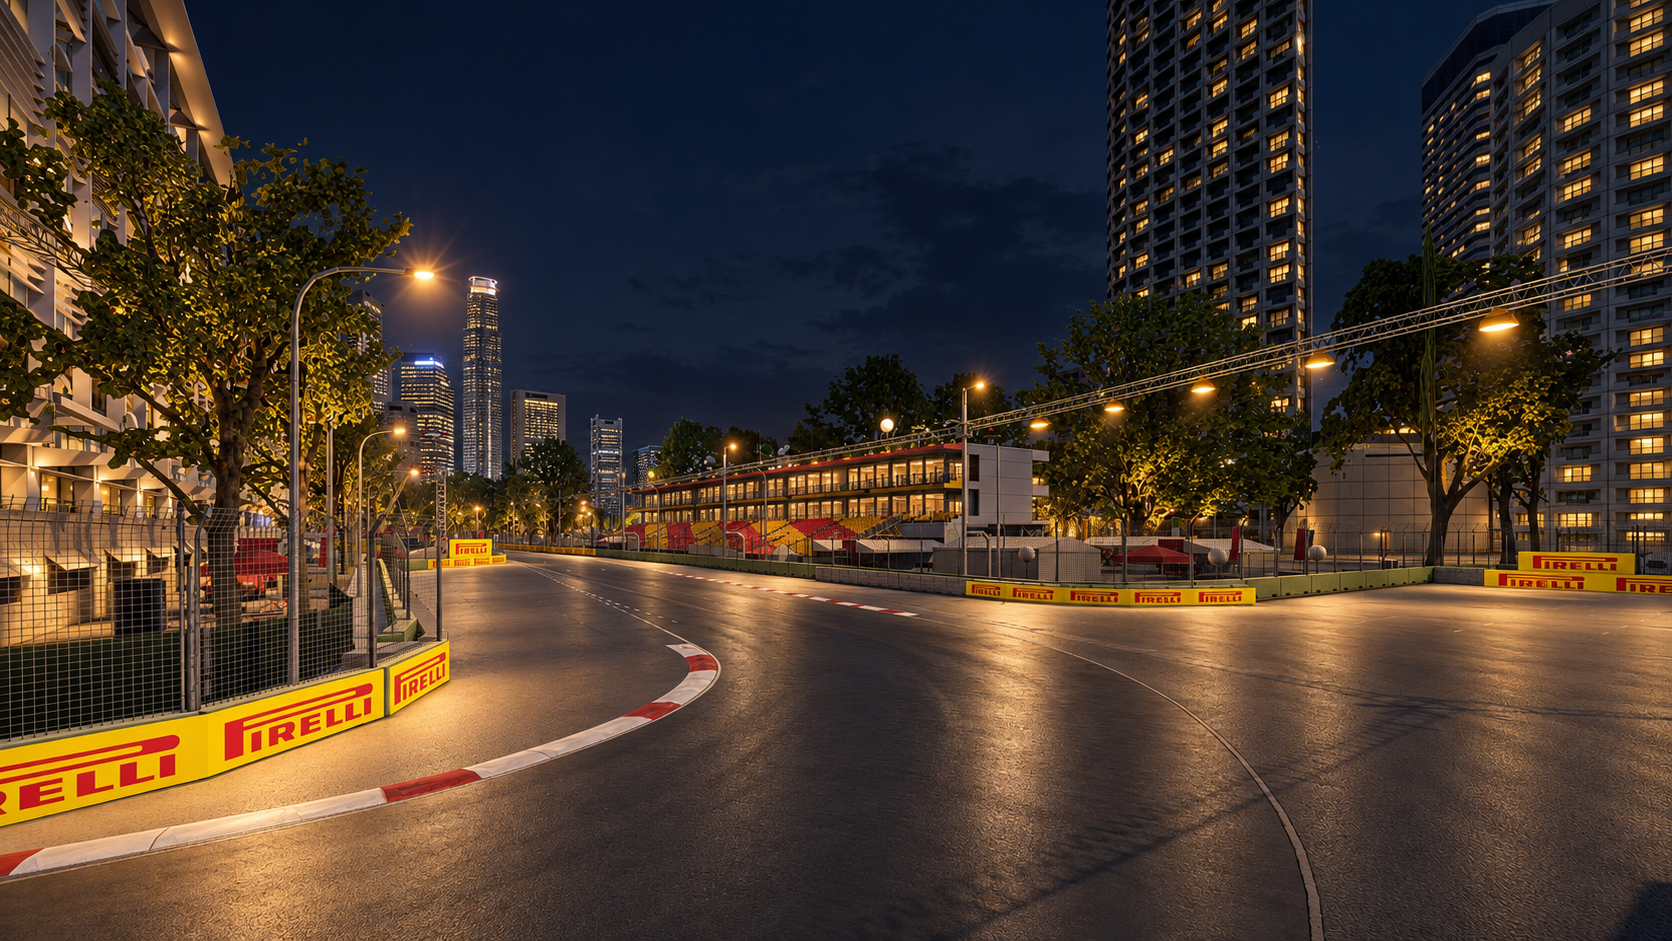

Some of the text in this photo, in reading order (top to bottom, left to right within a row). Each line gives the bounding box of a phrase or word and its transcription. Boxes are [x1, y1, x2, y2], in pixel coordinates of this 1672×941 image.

[1533, 556, 1619, 571] PIRELLI
[1499, 574, 1585, 589] PIRELLI
[1199, 591, 1243, 603] PIRELLI
[394, 652, 446, 705] PIRELLI
[224, 682, 374, 761] PIRELLI
